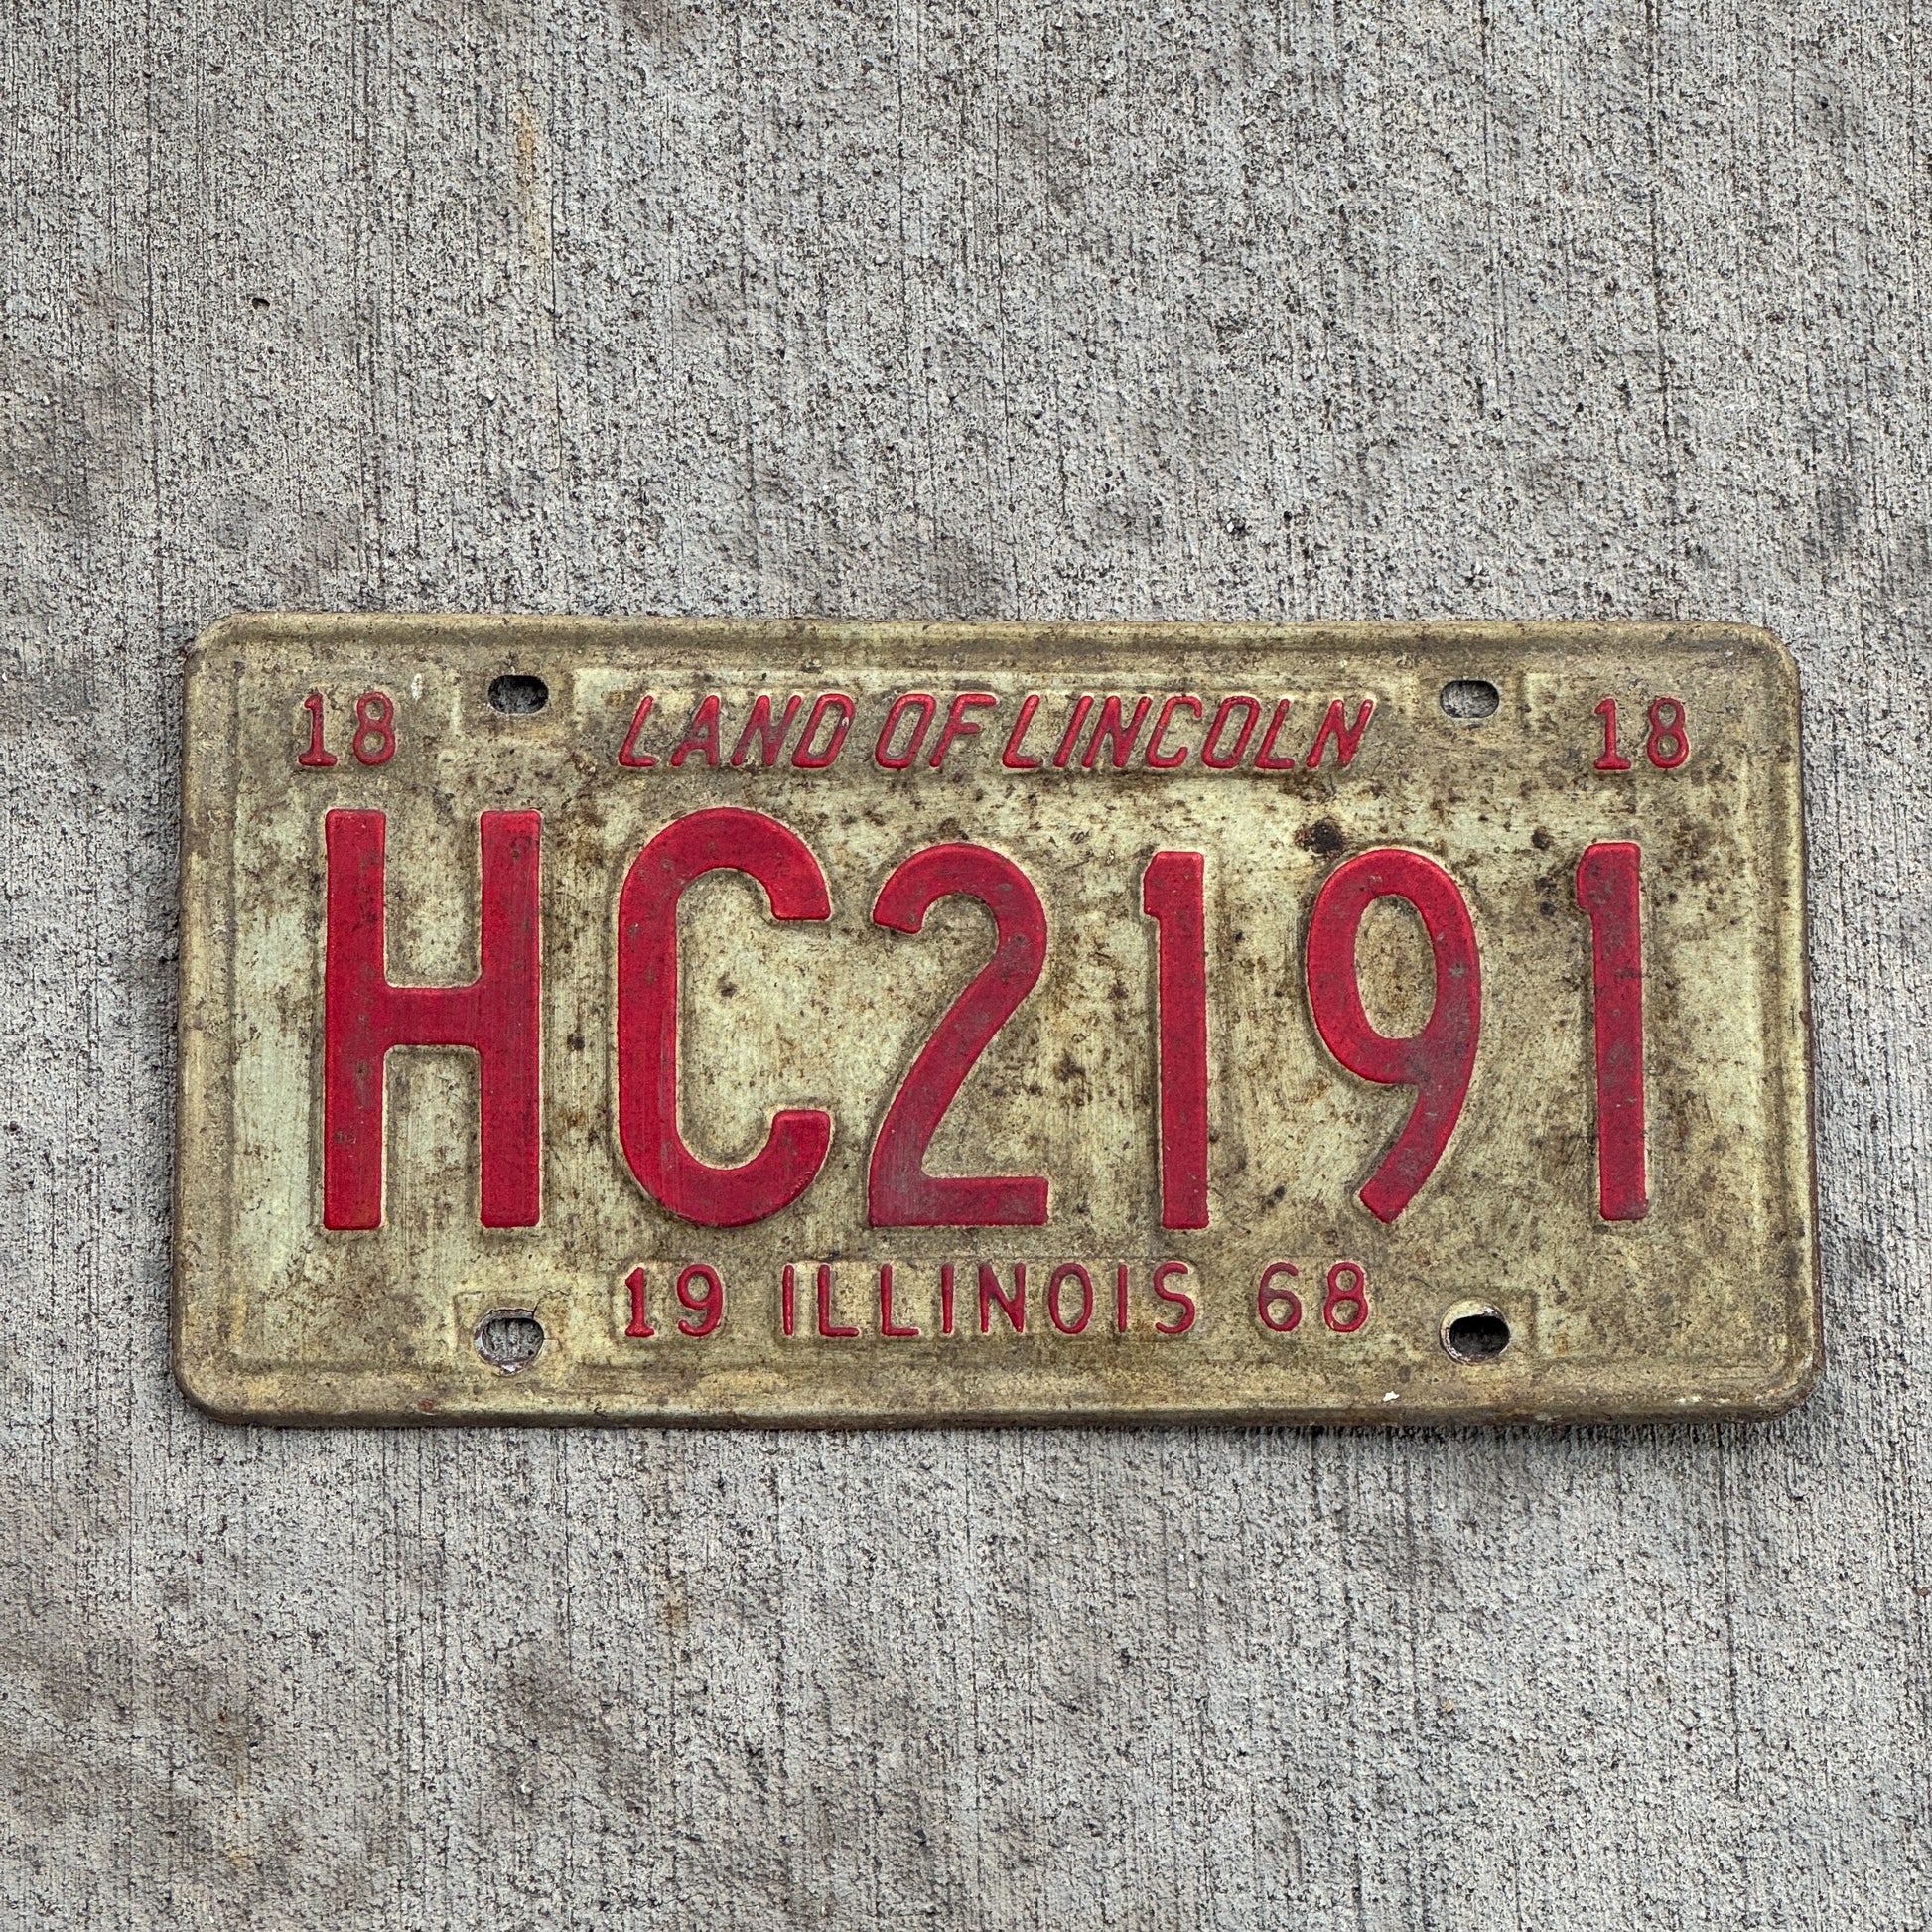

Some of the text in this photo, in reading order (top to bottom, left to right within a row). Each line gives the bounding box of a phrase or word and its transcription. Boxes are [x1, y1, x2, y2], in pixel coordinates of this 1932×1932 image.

[298, 690, 397, 768] 18
[617, 692, 1375, 771] LAND OF LINCOLN
[1593, 696, 1691, 771] 18
[322, 806, 1650, 1233] HC2191
[623, 1259, 1370, 1339] 19 ILLINOIS 68
